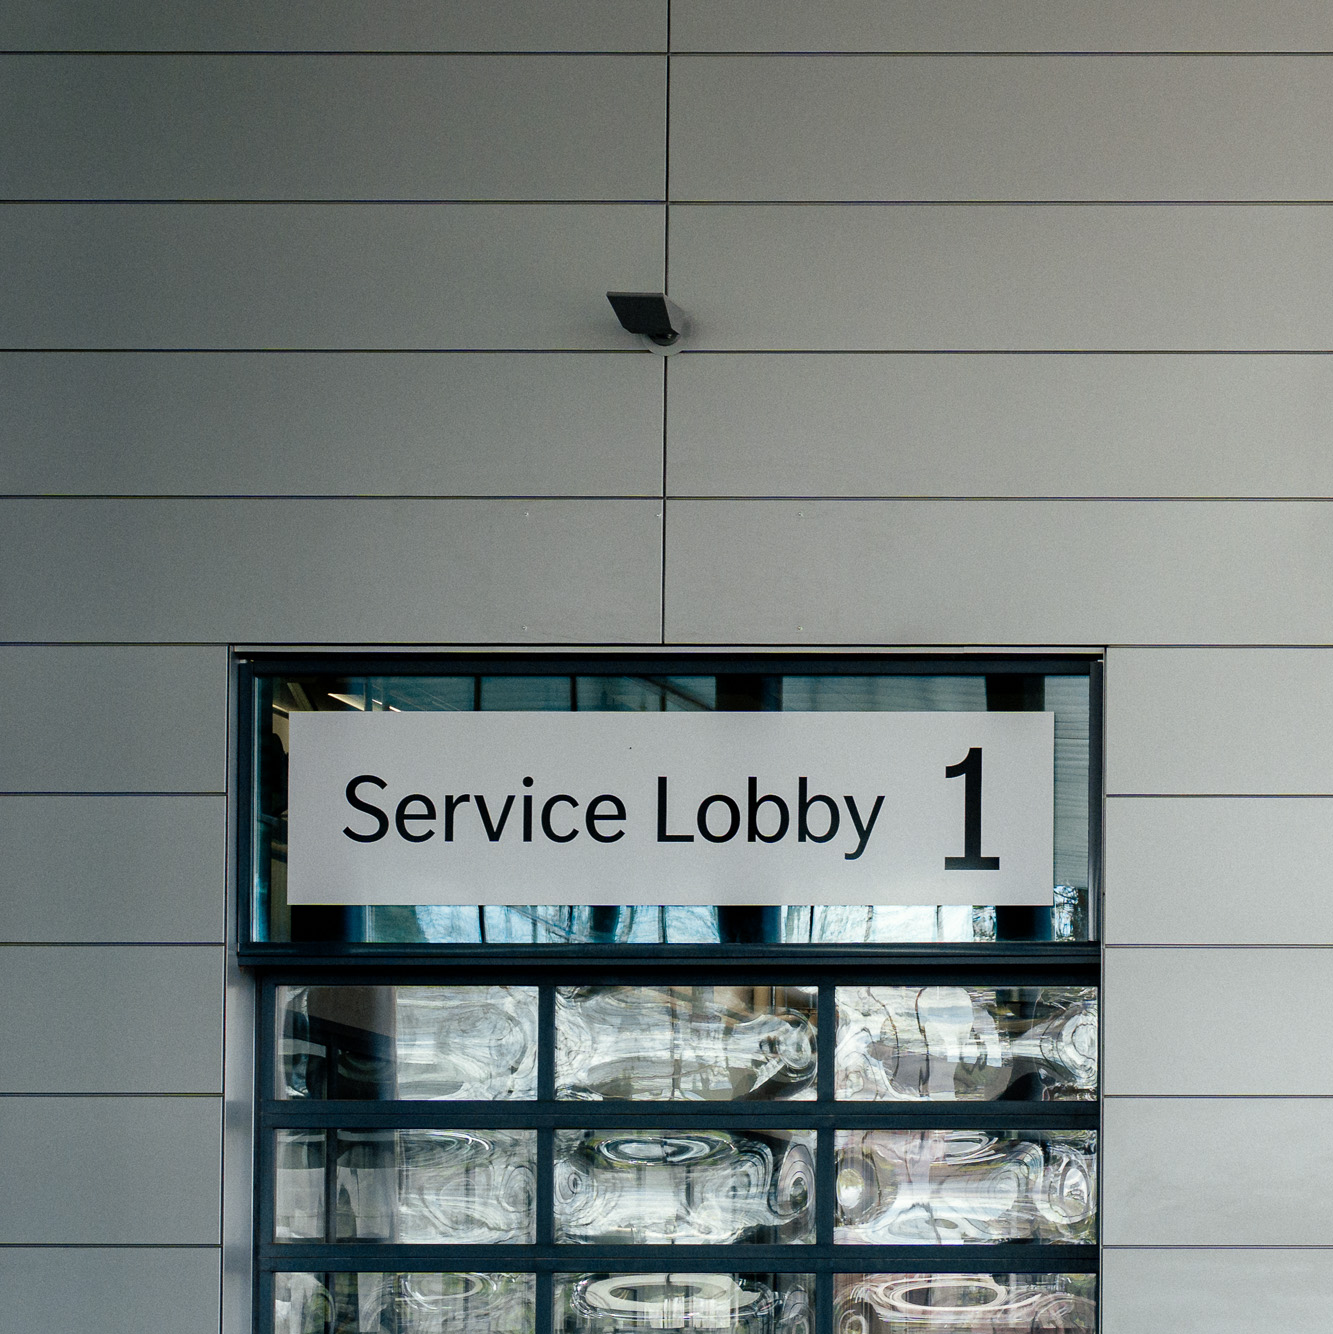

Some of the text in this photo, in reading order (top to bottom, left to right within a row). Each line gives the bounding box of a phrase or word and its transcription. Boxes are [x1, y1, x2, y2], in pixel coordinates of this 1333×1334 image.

[342, 746, 1001, 871] Service Lobby 1
